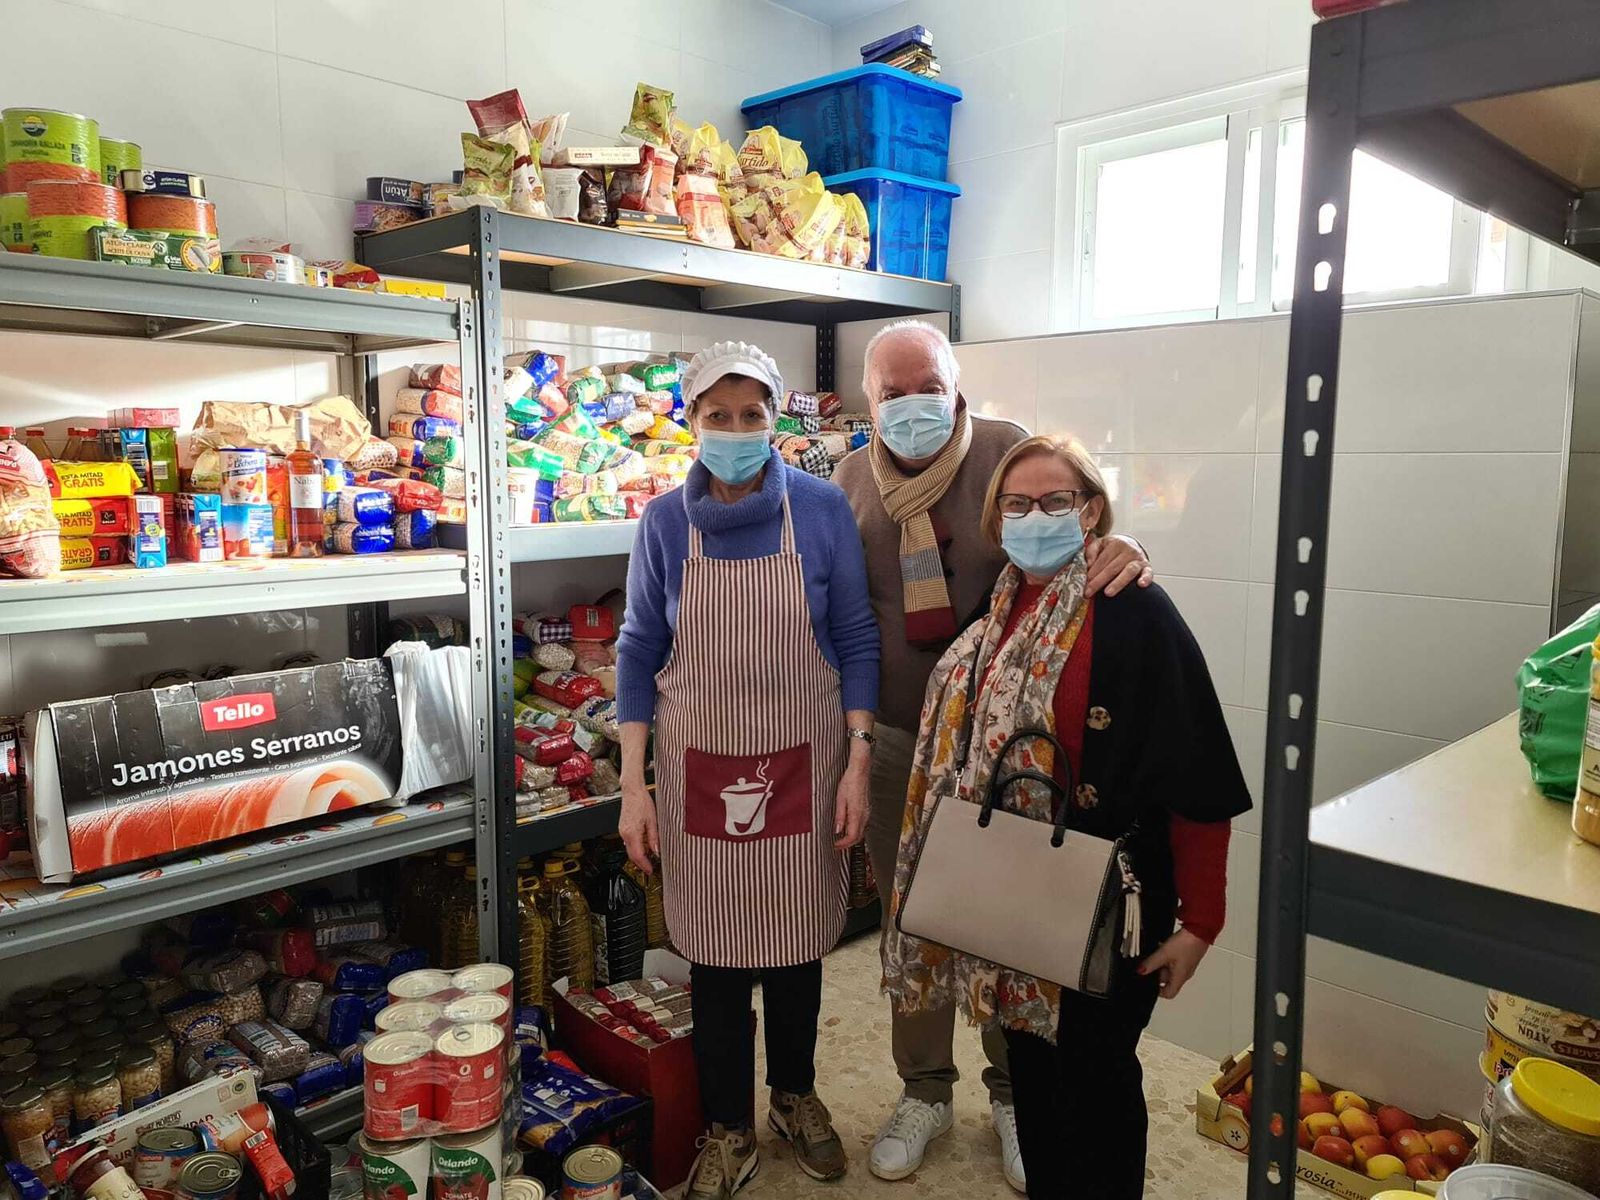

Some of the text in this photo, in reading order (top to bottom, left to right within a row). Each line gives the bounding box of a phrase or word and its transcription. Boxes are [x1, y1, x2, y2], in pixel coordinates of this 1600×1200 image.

[385, 186, 408, 197] Atún
[126, 241, 151, 250] CLARO
[64, 478, 105, 489] GRATIS
[69, 511, 92, 519] MITAD
[213, 702, 265, 723] Tello
[111, 725, 361, 787] Jamones Serranos
[116, 792, 140, 805] Aroma
[141, 785, 166, 797] intenso
[173, 775, 205, 789] agradable
[210, 771, 234, 780] Textura
[235, 766, 269, 776] consistente
[274, 763, 290, 771] Gran
[322, 748, 347, 761] Excelente
[348, 742, 361, 752] sabor
[1518, 1024, 1551, 1043] ATÚN
[438, 1156, 479, 1169] Orlando
[363, 1164, 396, 1176] rlando
[445, 1191, 472, 1199] TOMATE
